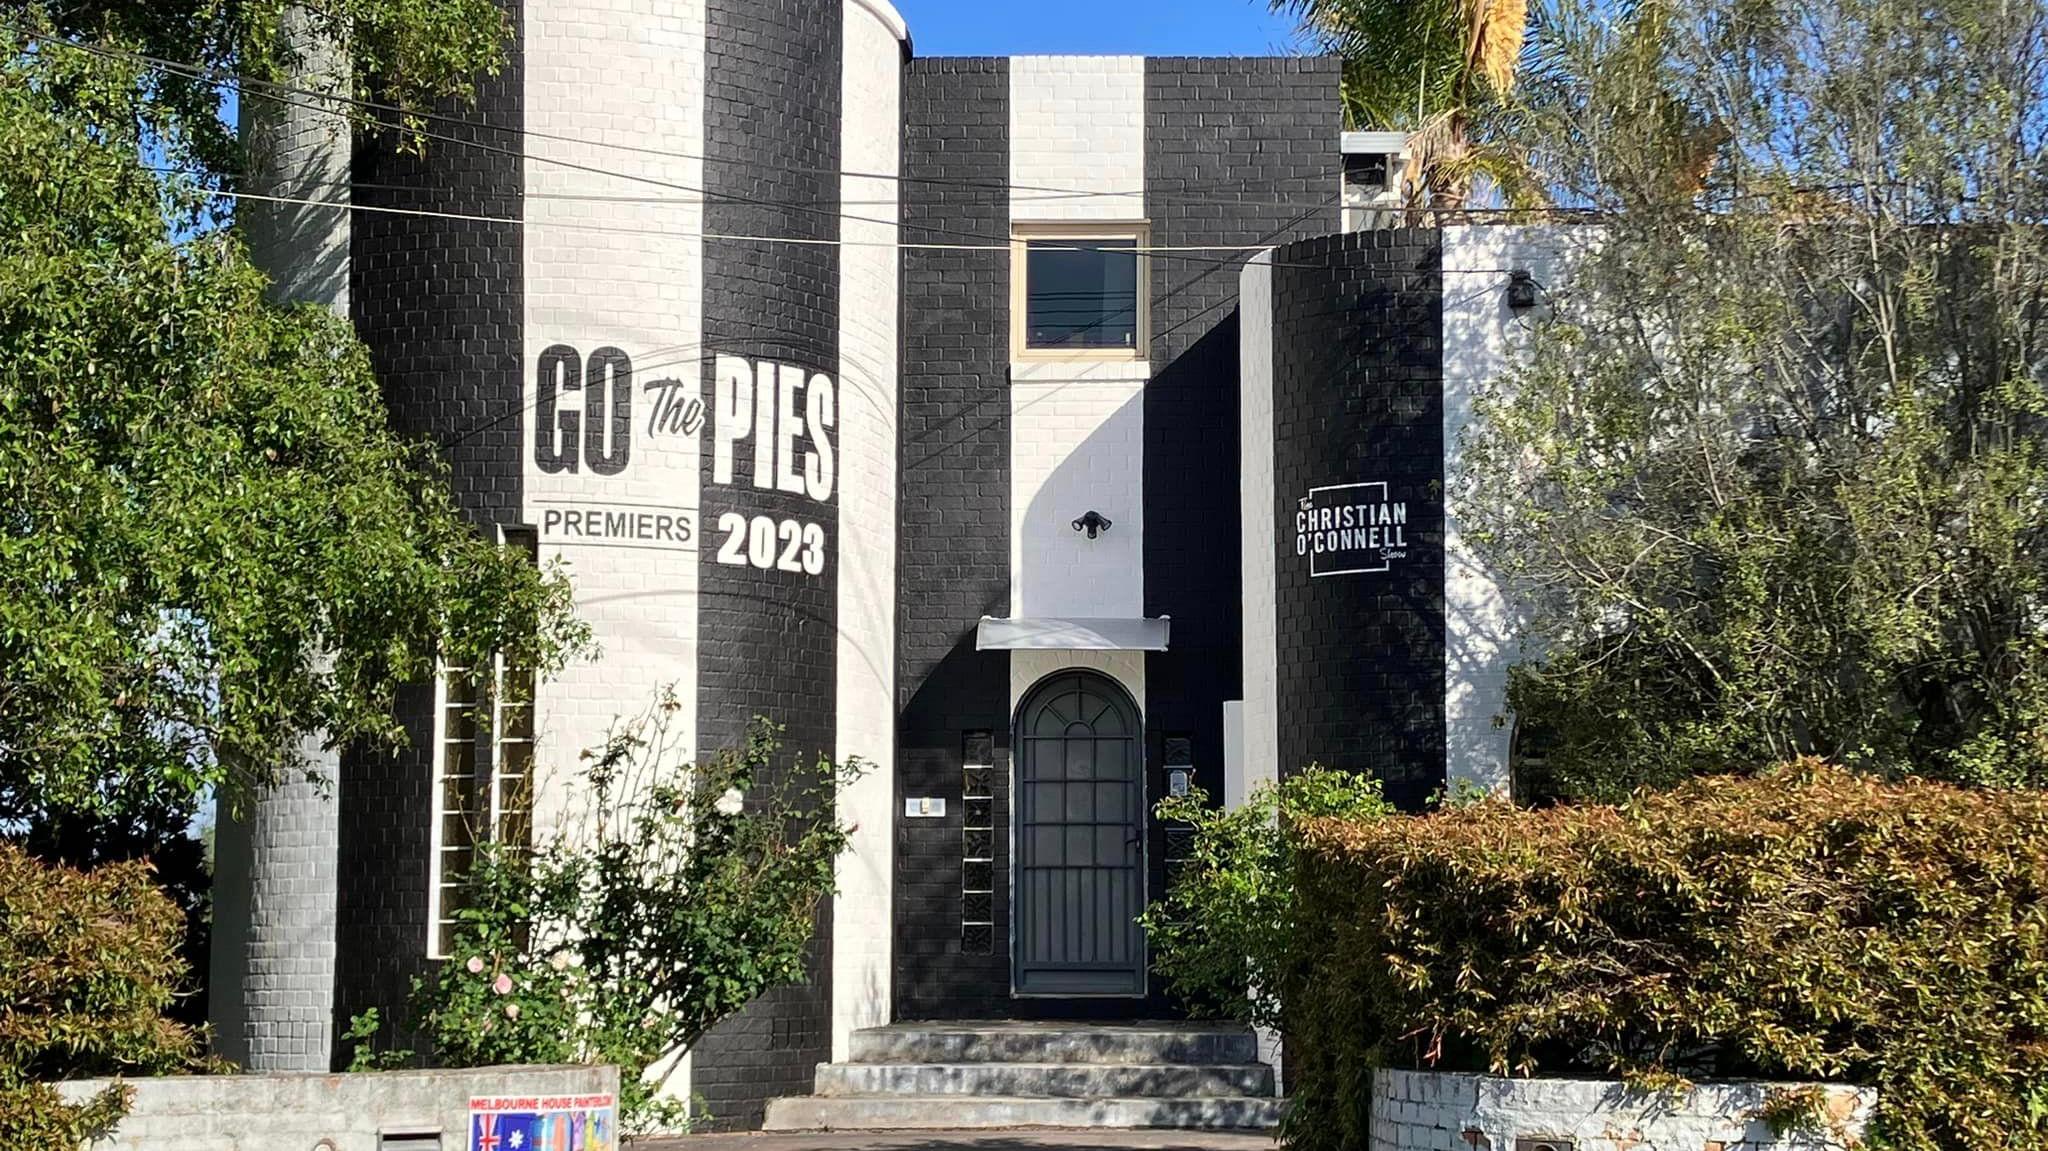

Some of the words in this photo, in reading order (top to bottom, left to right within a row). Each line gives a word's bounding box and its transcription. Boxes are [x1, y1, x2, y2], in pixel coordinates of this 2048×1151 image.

[534, 344, 632, 476] GO
[643, 376, 705, 439] The
[713, 353, 834, 501] PIES
[544, 510, 692, 542] PREMIERS
[1296, 502, 1407, 533] CHRISTIAN
[716, 513, 825, 575] 2023
[1296, 526, 1408, 556] O'CONNELL
[1379, 547, 1407, 560] Show
[471, 1098, 539, 1110] MELBOURNE
[541, 1097, 573, 1109] HOUSE
